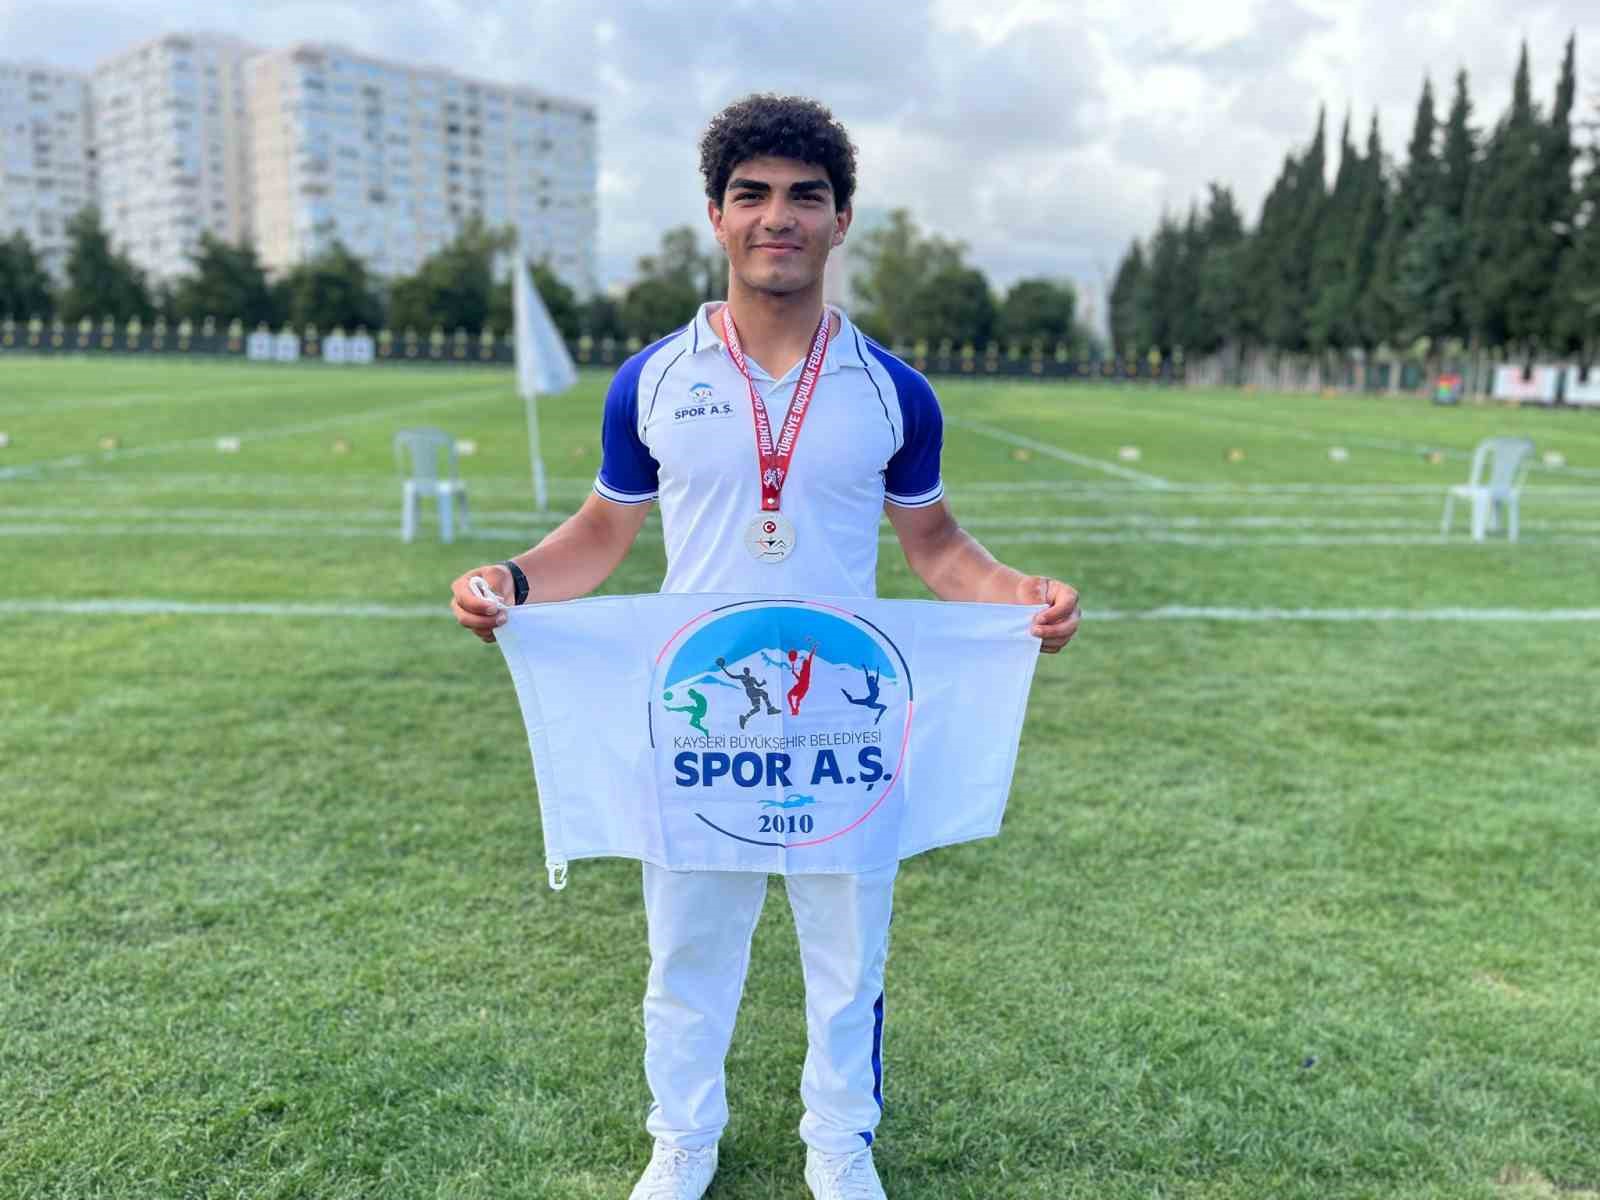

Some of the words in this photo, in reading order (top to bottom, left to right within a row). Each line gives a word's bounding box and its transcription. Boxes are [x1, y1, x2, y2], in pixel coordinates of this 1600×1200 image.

[674, 407, 705, 420] SPOR
[757, 412, 772, 456] TÜRKİYE
[777, 414, 800, 456] TÜRKİYE
[673, 734, 726, 749] KAYSERİ
[810, 731, 881, 747] BELEDİYESİ
[674, 751, 792, 788] SPOR
[810, 746, 892, 791] A.Ş.
[758, 814, 814, 833] 2010
